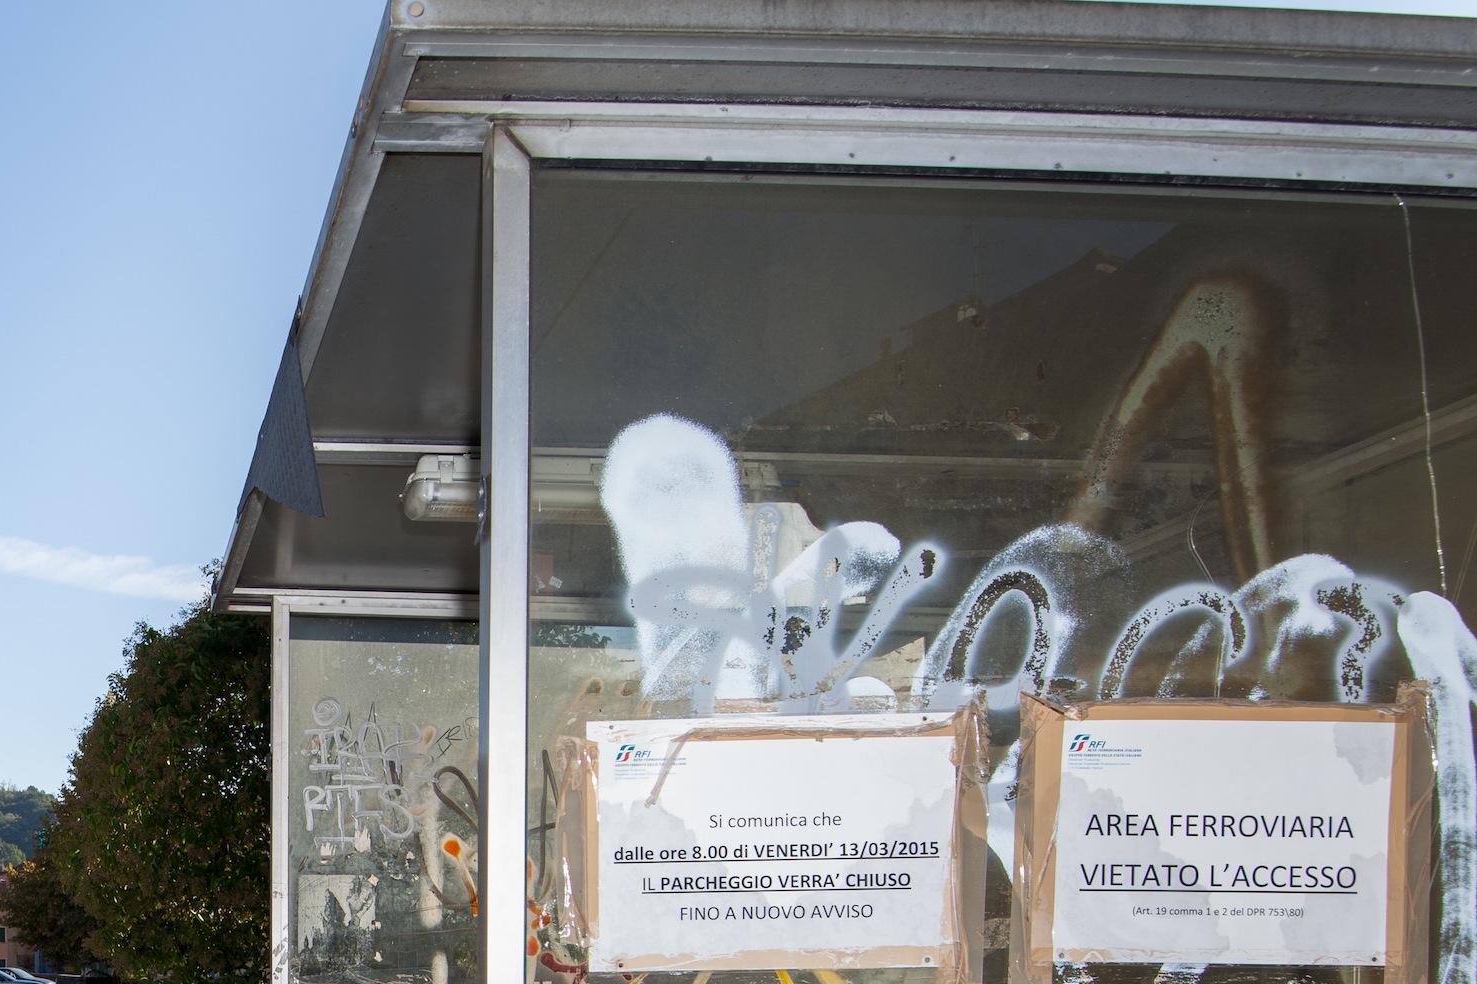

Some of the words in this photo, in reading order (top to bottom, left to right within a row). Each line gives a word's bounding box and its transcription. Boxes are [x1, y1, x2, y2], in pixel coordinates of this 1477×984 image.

[709, 814, 723, 829] Si
[728, 813, 807, 828] comunica
[813, 812, 841, 826] che
[1085, 814, 1159, 836] AREA
[1171, 815, 1353, 838] FERROVIARIA
[614, 846, 657, 860] dalle
[660, 850, 686, 859] ore
[692, 846, 727, 859] 8.00
[734, 845, 747, 858] di
[753, 842, 835, 858] VENERDI'
[840, 841, 939, 857] 13/03/2015
[642, 878, 656, 891] IL
[660, 875, 773, 890] PARCHEGGIO
[778, 873, 842, 888] VERRA'
[846, 873, 910, 887] CHIUSO
[1081, 864, 1198, 886] VIETATO
[1211, 864, 1356, 888] L'ACCESSO
[681, 907, 719, 920] FINO
[725, 907, 736, 919] A
[743, 906, 805, 919] NUOVO
[811, 905, 873, 918] AVVISO
[1133, 907, 1152, 916] (Art.
[1157, 907, 1166, 915] 19
[1230, 908, 1244, 916] del
[1247, 908, 1265, 916] DPR
[1269, 908, 1303, 918] 753\80)
